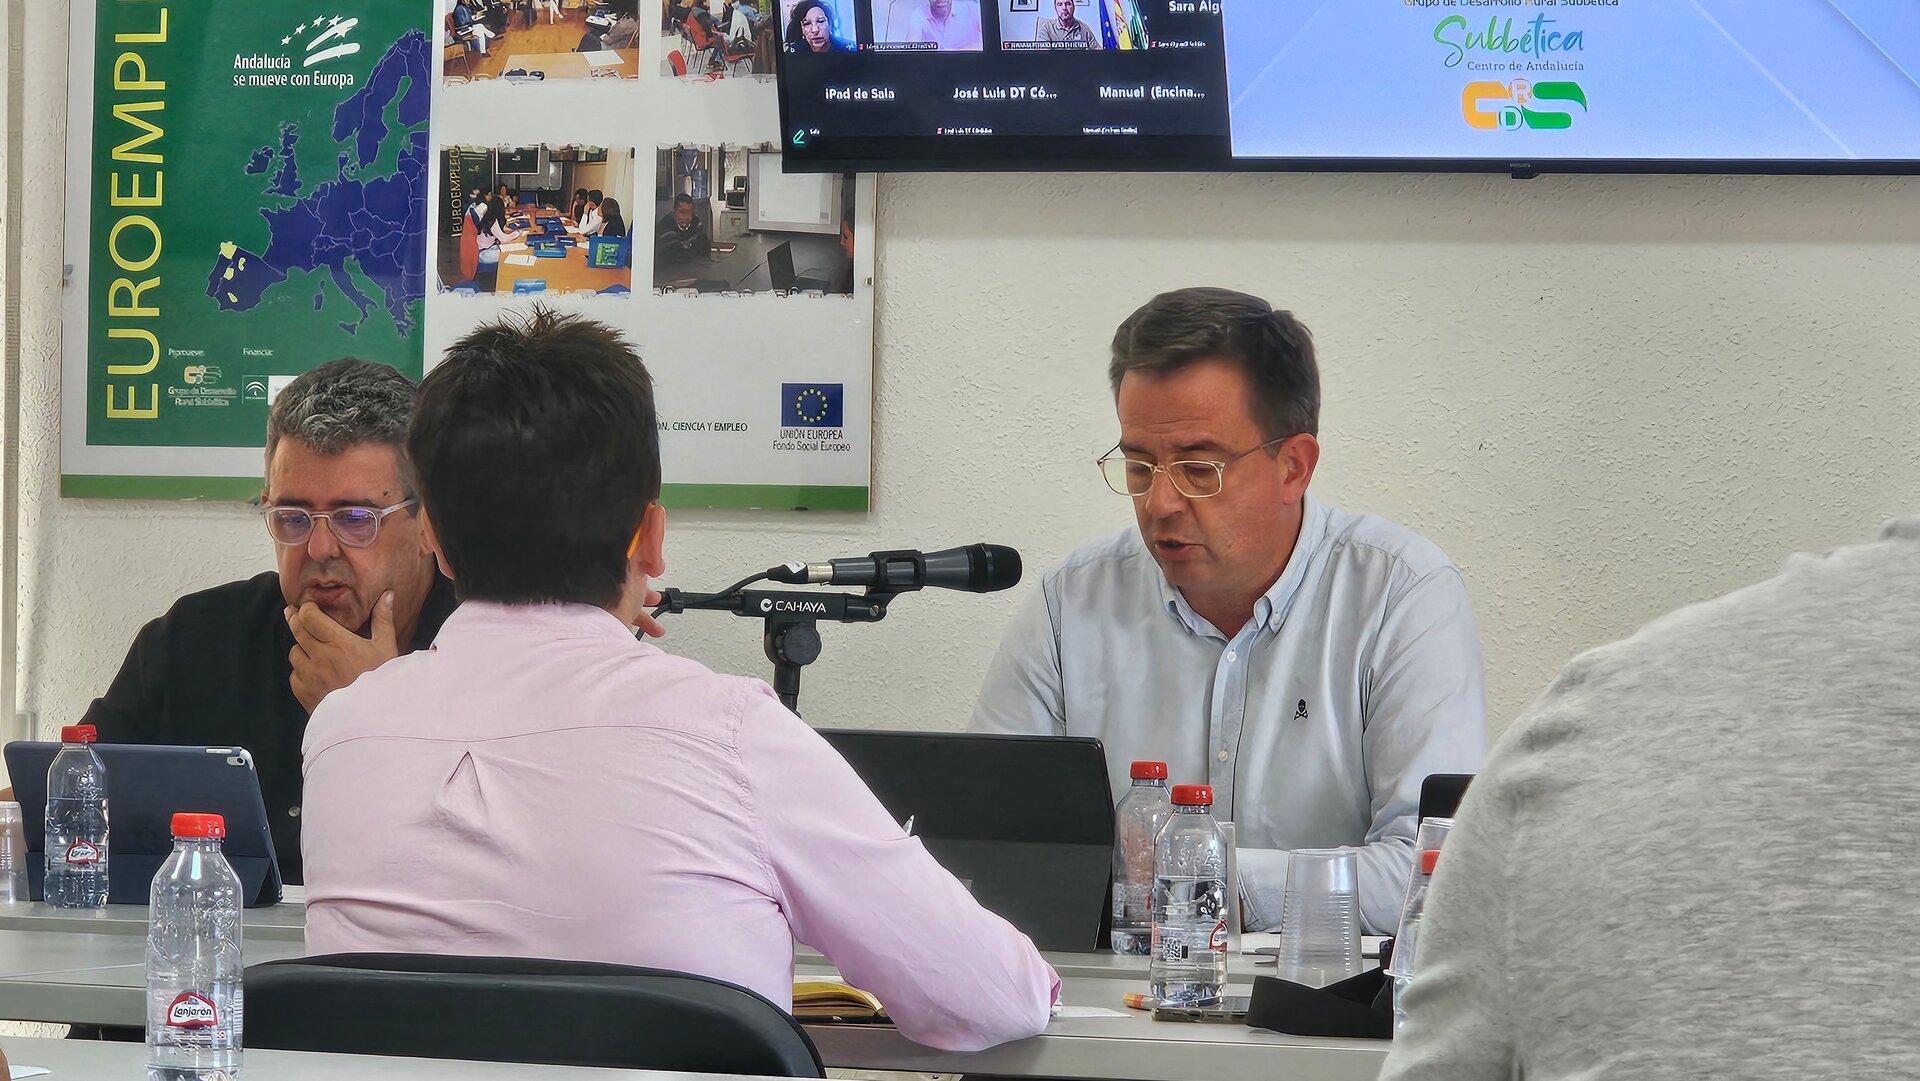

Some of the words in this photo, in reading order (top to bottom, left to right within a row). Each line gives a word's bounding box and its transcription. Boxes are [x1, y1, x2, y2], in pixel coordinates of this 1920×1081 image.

[1434, 12, 1584, 68] Subbética
[233, 53, 291, 69] Andalucía
[1467, 61, 1506, 71] Centro
[1509, 61, 1522, 71] de
[1526, 61, 1584, 71] Andalucía
[233, 74, 246, 86] se
[248, 74, 288, 86] mueve
[290, 74, 310, 86] con
[313, 70, 354, 89] Europa
[825, 87, 851, 100] iPad
[853, 87, 868, 99] de
[953, 87, 979, 99] José
[982, 87, 1006, 99] Luis
[1010, 87, 1026, 99] DT
[1099, 86, 1145, 99] Manuel
[672, 421, 706, 431] CIENCIA
[707, 422, 713, 431] Y
[714, 422, 748, 432] EMPLEO
[807, 429, 844, 440] EUROPEA
[772, 440, 796, 451] Fondo
[796, 440, 819, 451] Social
[820, 440, 851, 452] Europeo
[775, 600, 827, 613] CAHAYA
